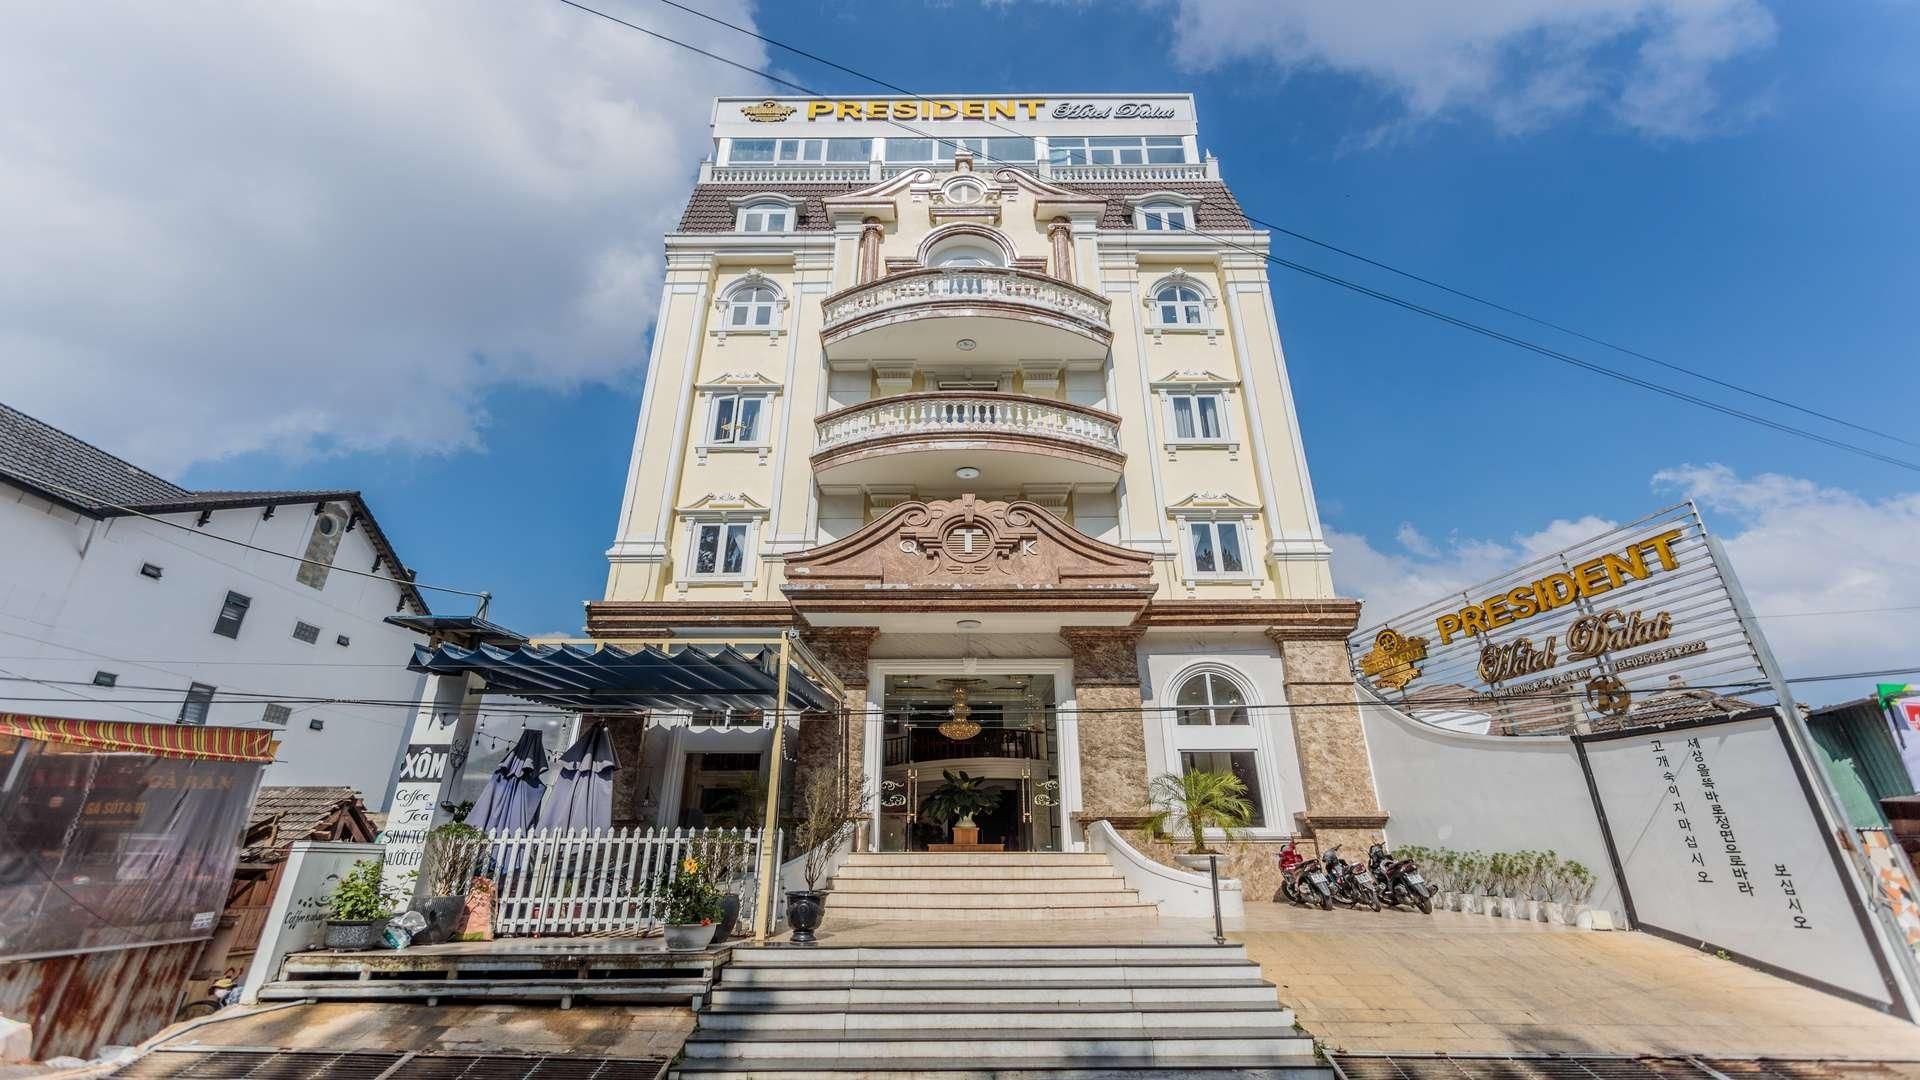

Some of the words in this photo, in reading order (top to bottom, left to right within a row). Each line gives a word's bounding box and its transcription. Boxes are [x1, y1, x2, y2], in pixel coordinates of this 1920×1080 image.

[807, 99, 1045, 121] PRESIDENT
[1052, 103, 1110, 119] Hotel
[900, 540, 920, 556] Q
[953, 528, 984, 553] T
[1023, 539, 1038, 556] K
[1435, 529, 1683, 645] PRESIDENT
[1478, 635, 1558, 683] Hotel
[1566, 607, 1672, 662] Dalat
[396, 789, 431, 807] Coffee
[399, 809, 429, 824] Tea
[1774, 863, 1812, 929] 보십시오
